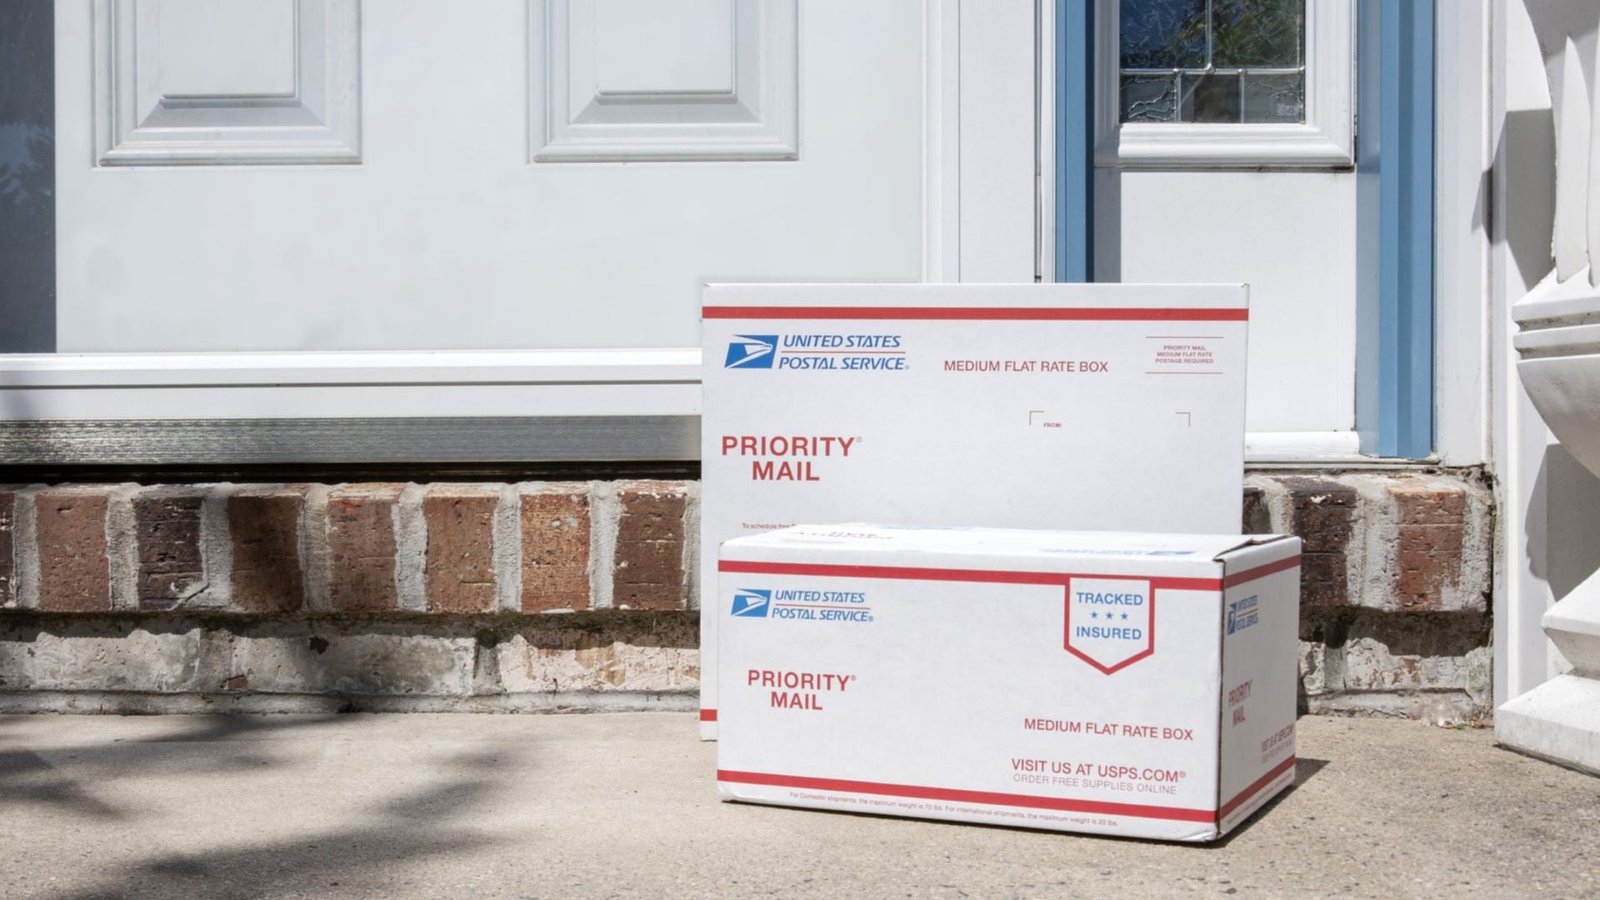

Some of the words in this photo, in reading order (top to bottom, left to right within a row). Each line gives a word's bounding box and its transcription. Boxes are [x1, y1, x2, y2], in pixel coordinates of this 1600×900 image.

[783, 335, 843, 348] UNITED
[845, 335, 902, 348] STATES
[778, 357, 837, 370] POSTAL
[841, 357, 906, 370] SERVICE
[943, 360, 1000, 372] MEDIUM
[1004, 360, 1037, 372] FLAT
[1040, 361, 1075, 373] RATE
[1079, 361, 1109, 373] BOX
[722, 436, 855, 456] PRIORITY
[752, 461, 820, 481] MAIL
[775, 590, 821, 601] UNITED
[822, 591, 865, 603] STATES
[1076, 592, 1143, 606] TRACKED
[772, 607, 817, 620] POSTAL
[1076, 626, 1142, 640] INSURED
[748, 669, 850, 691] PRIORITY
[770, 691, 823, 710] MAIL
[1024, 718, 1081, 733] MEDIUM
[1086, 722, 1118, 735] FLAT
[1122, 725, 1158, 738] RATE
[1163, 727, 1194, 740] BOX
[1011, 758, 1047, 773] VISIT
[1051, 762, 1072, 774] US
[1076, 764, 1094, 776] AT
[1013, 773, 1049, 785] ORDER
[1052, 776, 1079, 787] FREE
[1082, 779, 1133, 792] SUPPLIES
[1137, 783, 1177, 795] ONLINE
